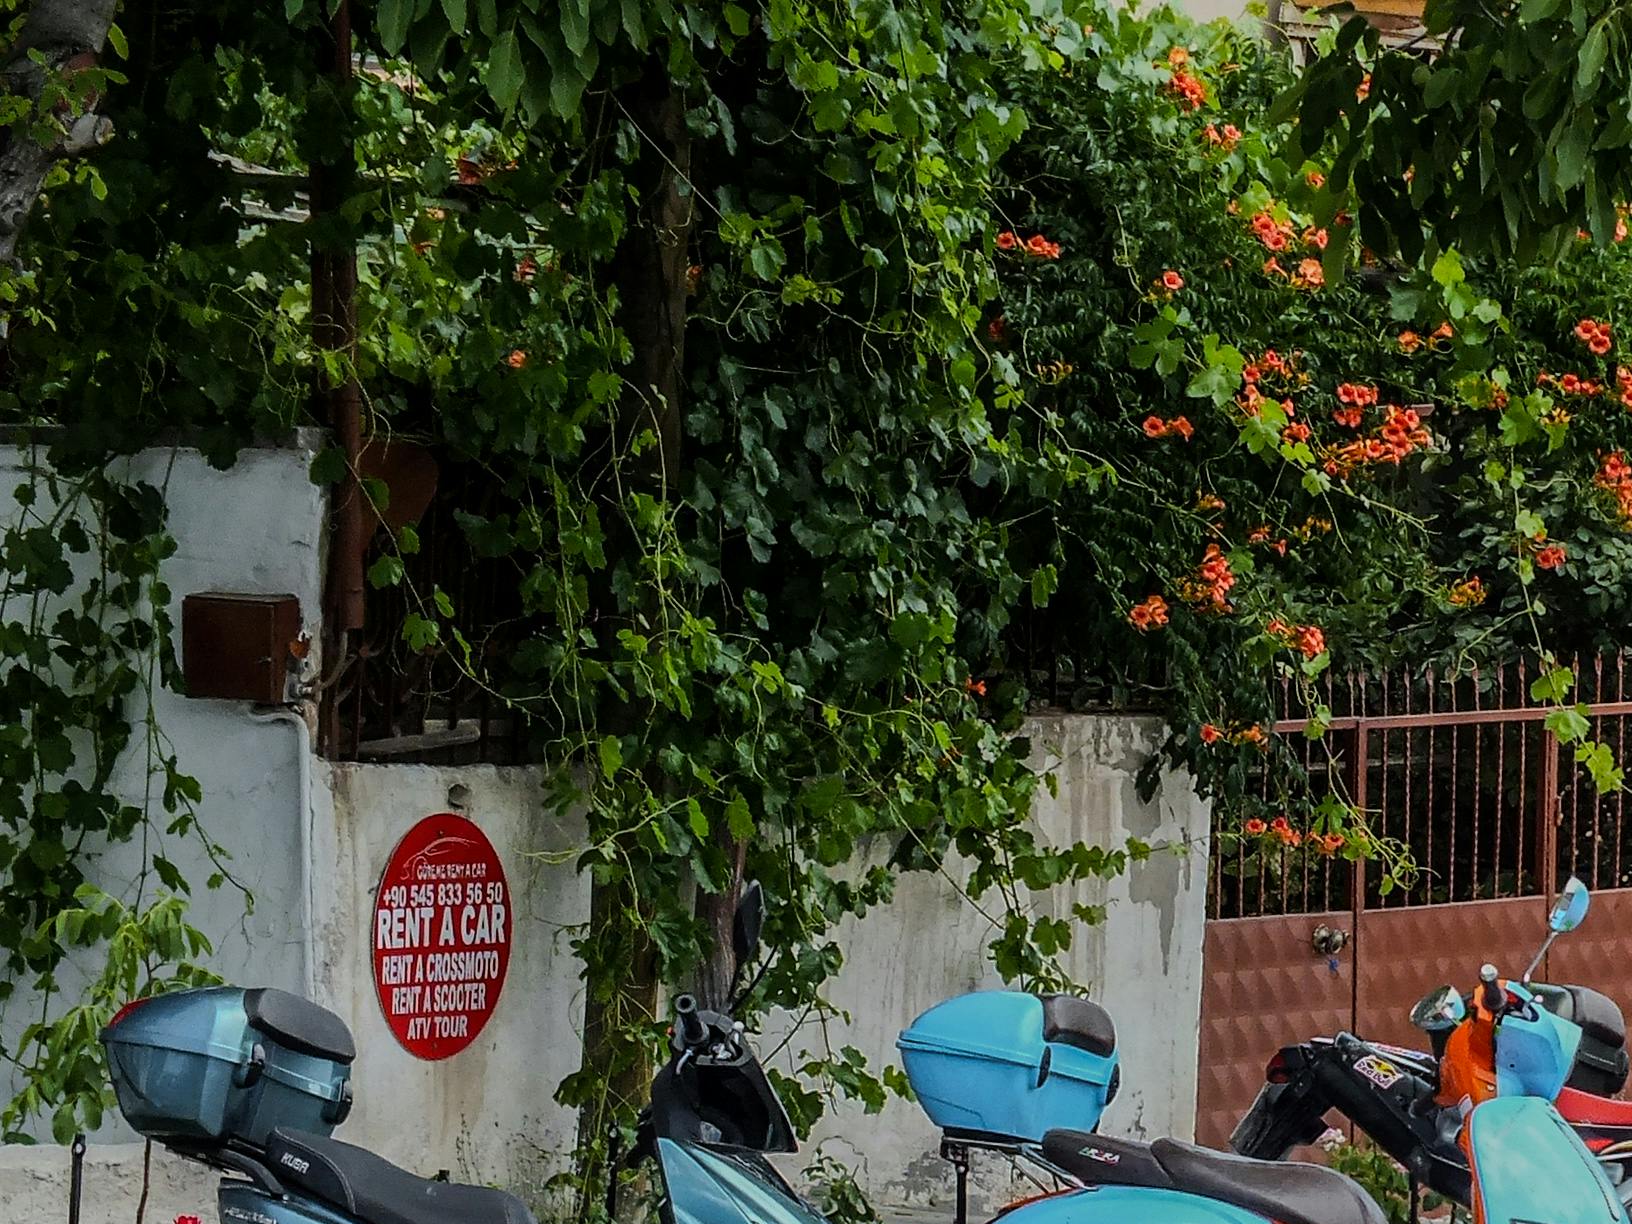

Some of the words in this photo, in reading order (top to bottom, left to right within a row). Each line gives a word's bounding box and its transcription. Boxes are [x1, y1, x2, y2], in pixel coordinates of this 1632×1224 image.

[465, 863, 471, 878] A
[471, 862, 487, 878] CAR
[383, 885, 407, 908] +90
[409, 883, 435, 907] 545
[437, 882, 462, 906] 833
[465, 881, 483, 905] 56
[486, 881, 503, 904] 50
[377, 907, 435, 950] RENT
[438, 906, 455, 947] A
[460, 904, 506, 946] CAR
[381, 954, 413, 985] RENT
[414, 953, 424, 983] A
[426, 950, 499, 982] CROSSMOTO
[391, 985, 422, 1015] RENT
[422, 985, 432, 1013] A
[433, 982, 486, 1012] SCOOTER
[406, 1016, 432, 1040] ATV
[433, 1014, 468, 1038] TOUR
